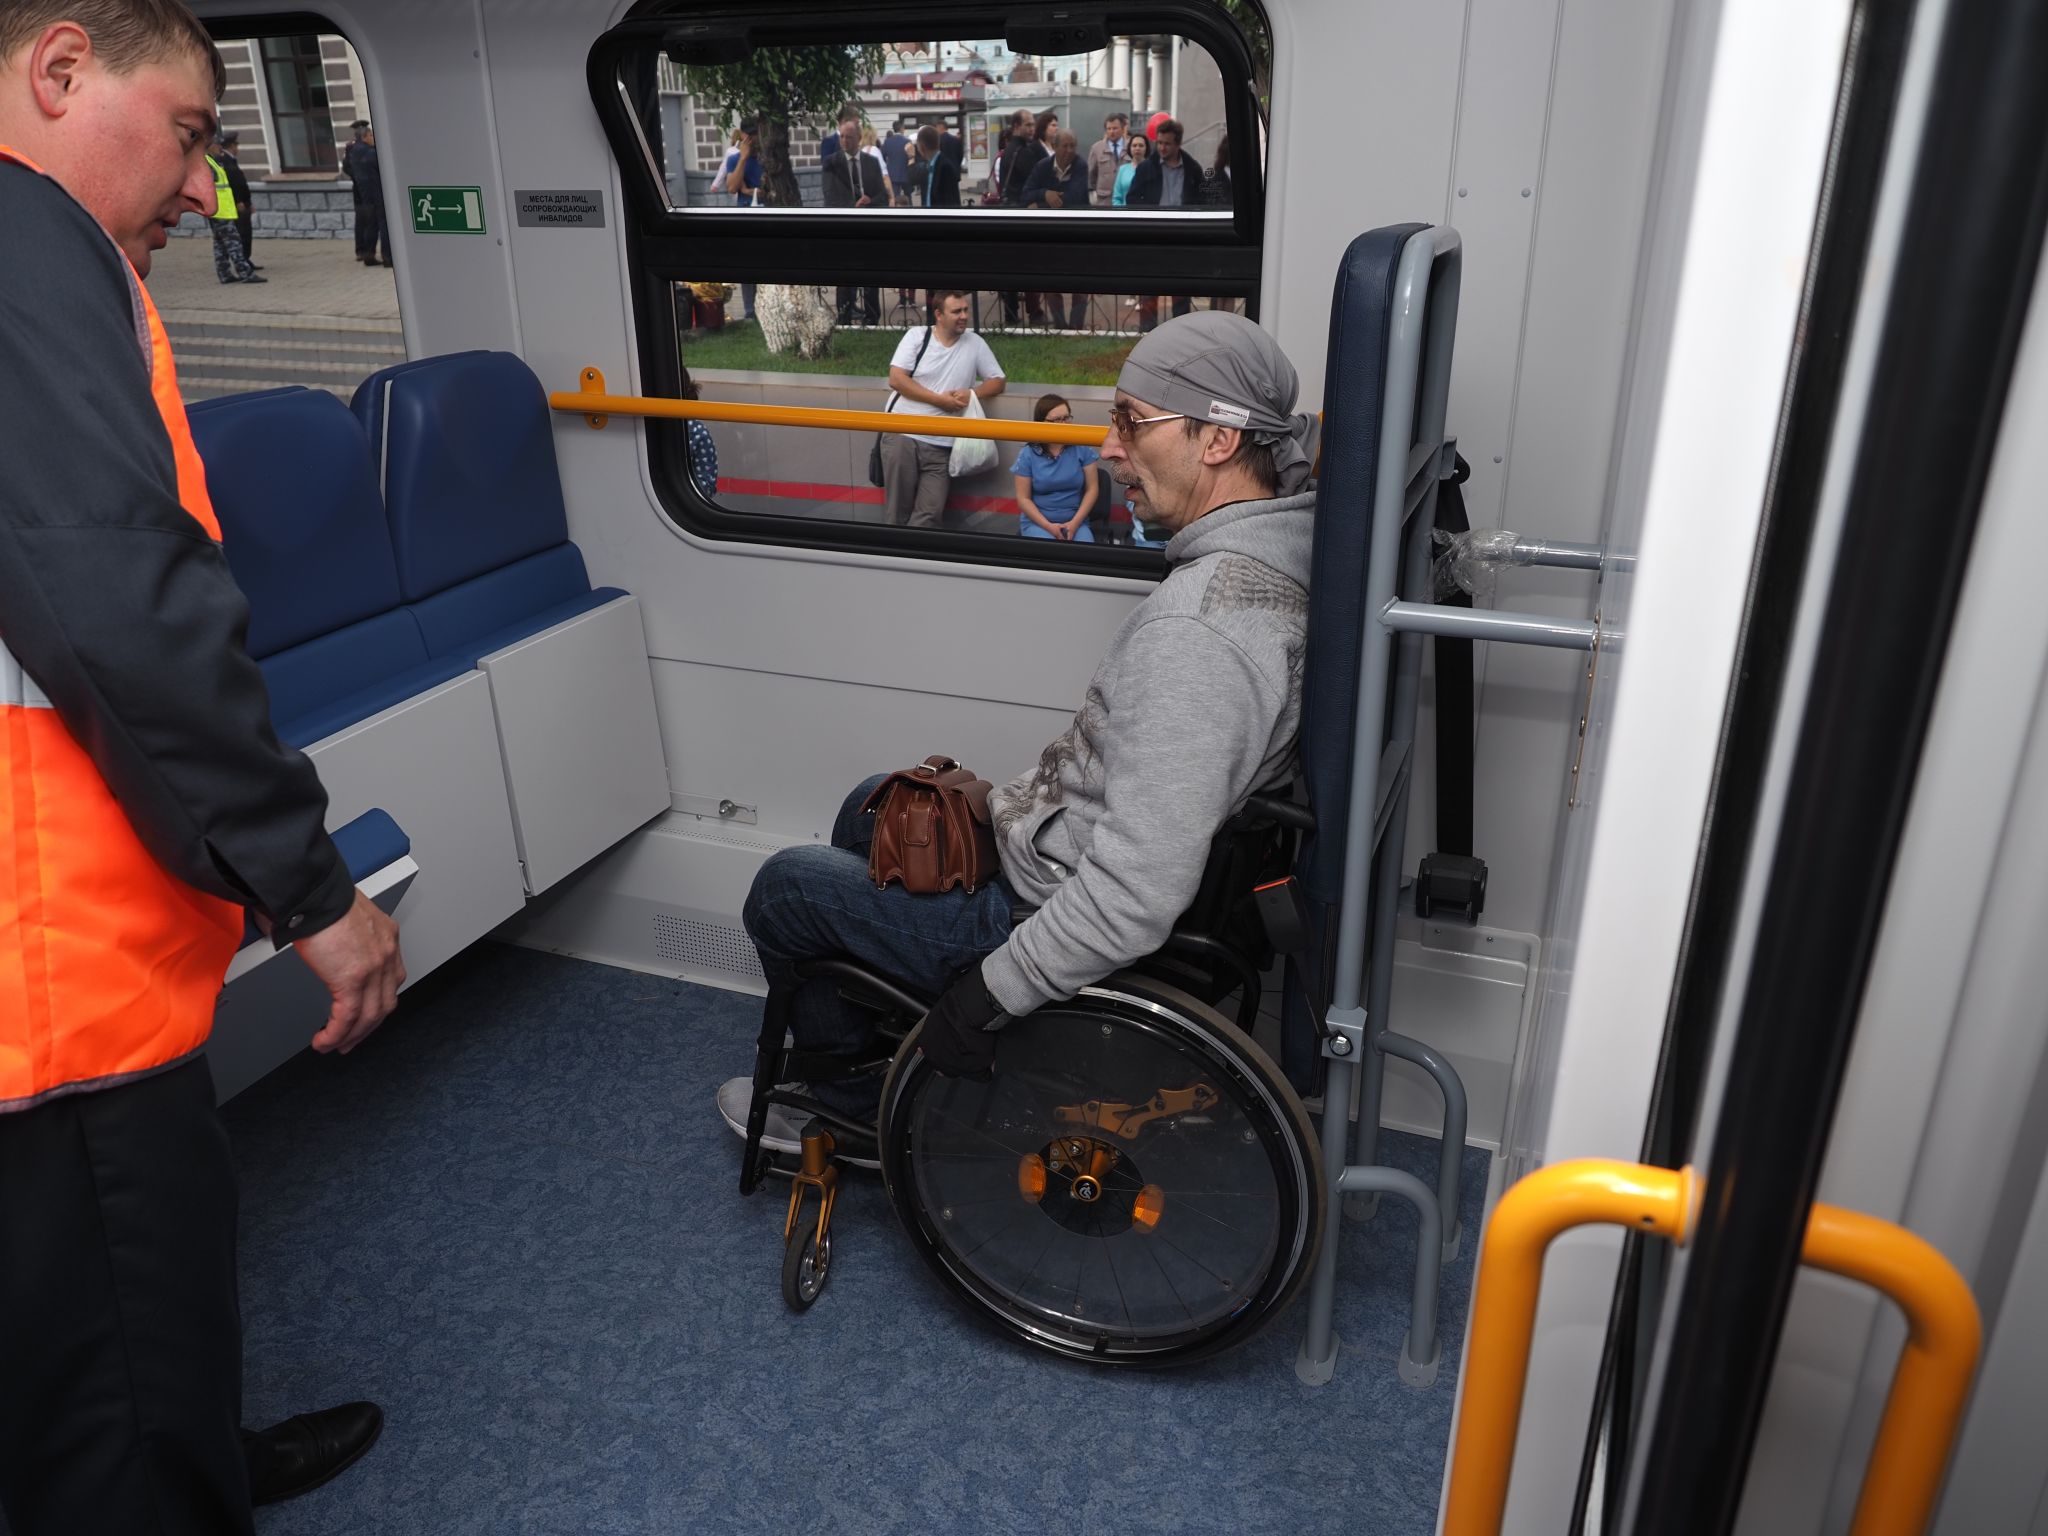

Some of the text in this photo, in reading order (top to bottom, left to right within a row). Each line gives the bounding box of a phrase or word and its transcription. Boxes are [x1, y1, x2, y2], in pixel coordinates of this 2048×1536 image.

[529, 195, 553, 203] МЕСТА
[554, 195, 570, 204] ДЛЯ
[522, 205, 597, 213] СОПРОВОЖДАЮЩИХ
[538, 214, 583, 223] ИНВАЛИДОВ
